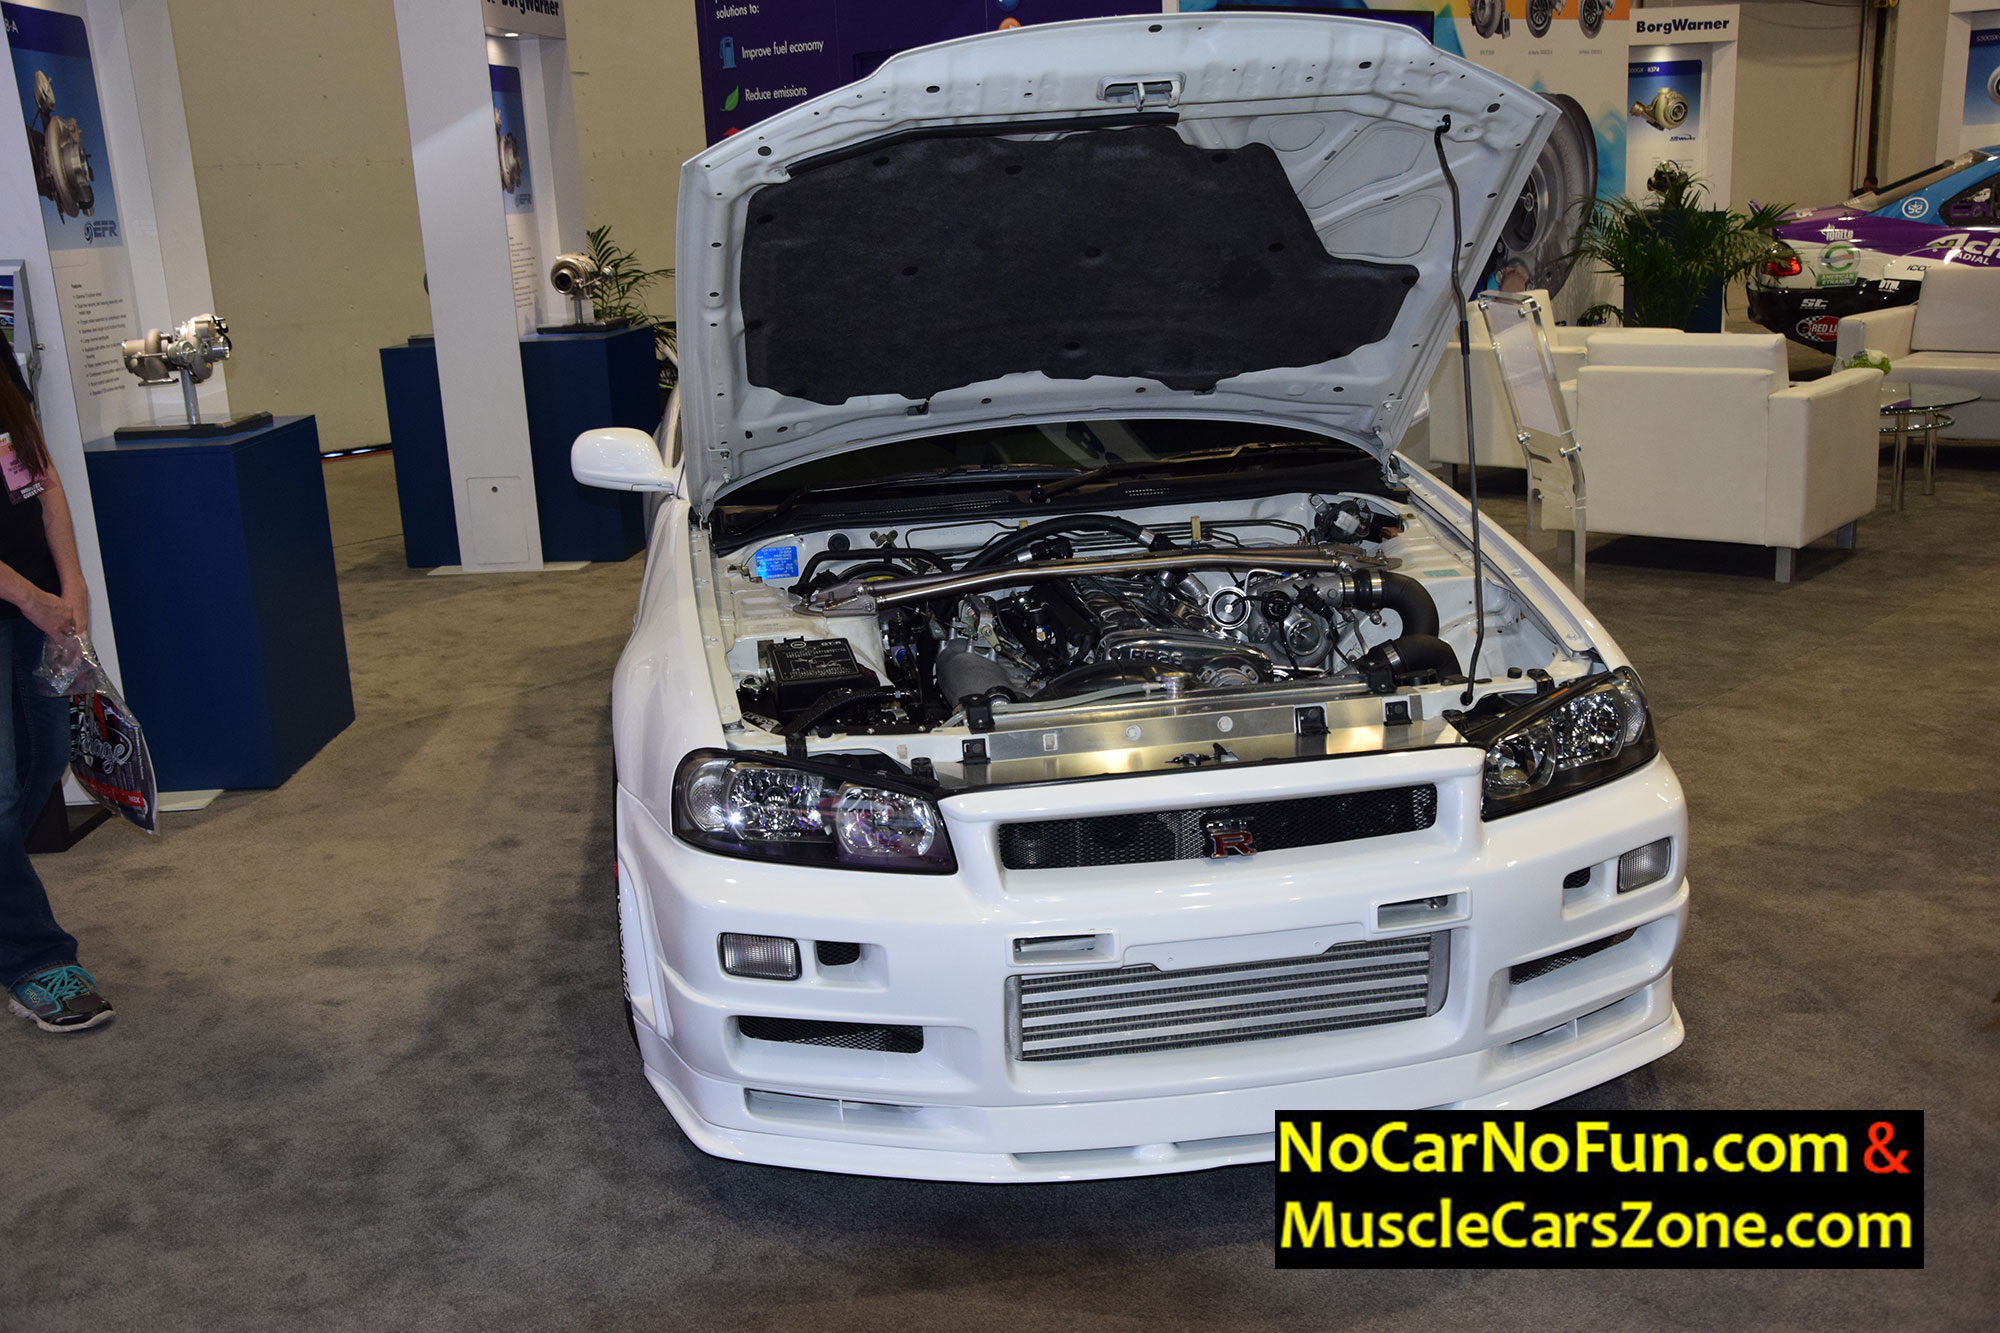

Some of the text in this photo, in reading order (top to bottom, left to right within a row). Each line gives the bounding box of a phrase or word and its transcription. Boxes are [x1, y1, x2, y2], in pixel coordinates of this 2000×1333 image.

[716, 4, 760, 19] solutions to:
[1636, 19, 1730, 35] BorgWarner
[741, 40, 824, 61] Improve fuel economy
[745, 85, 808, 101] Reduce emissions
[93, 220, 118, 238] EFR
[1954, 251, 1990, 266] ADIAL
[1811, 324, 1827, 333] RED
[1210, 831, 1257, 859] R
